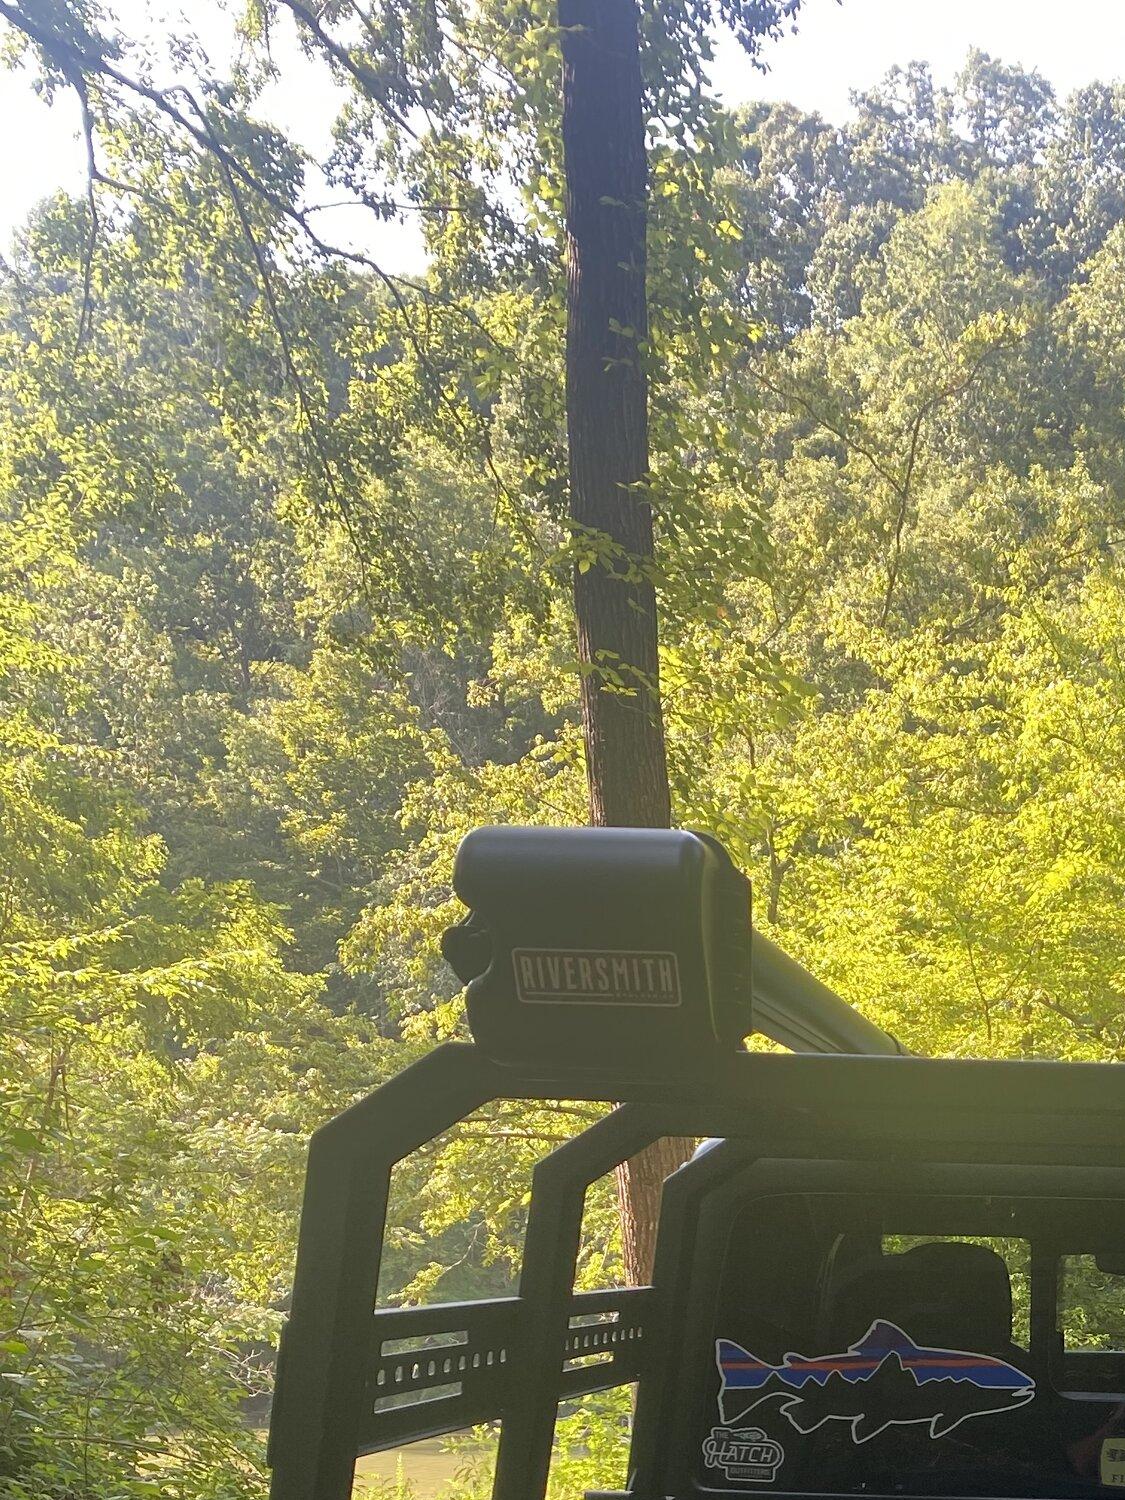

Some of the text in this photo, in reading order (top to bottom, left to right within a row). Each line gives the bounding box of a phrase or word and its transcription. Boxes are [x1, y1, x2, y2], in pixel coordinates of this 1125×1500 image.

[520, 955, 673, 992] RIVERSMITH
[715, 1431, 729, 1439] THE
[707, 1441, 773, 1463] HATCH
